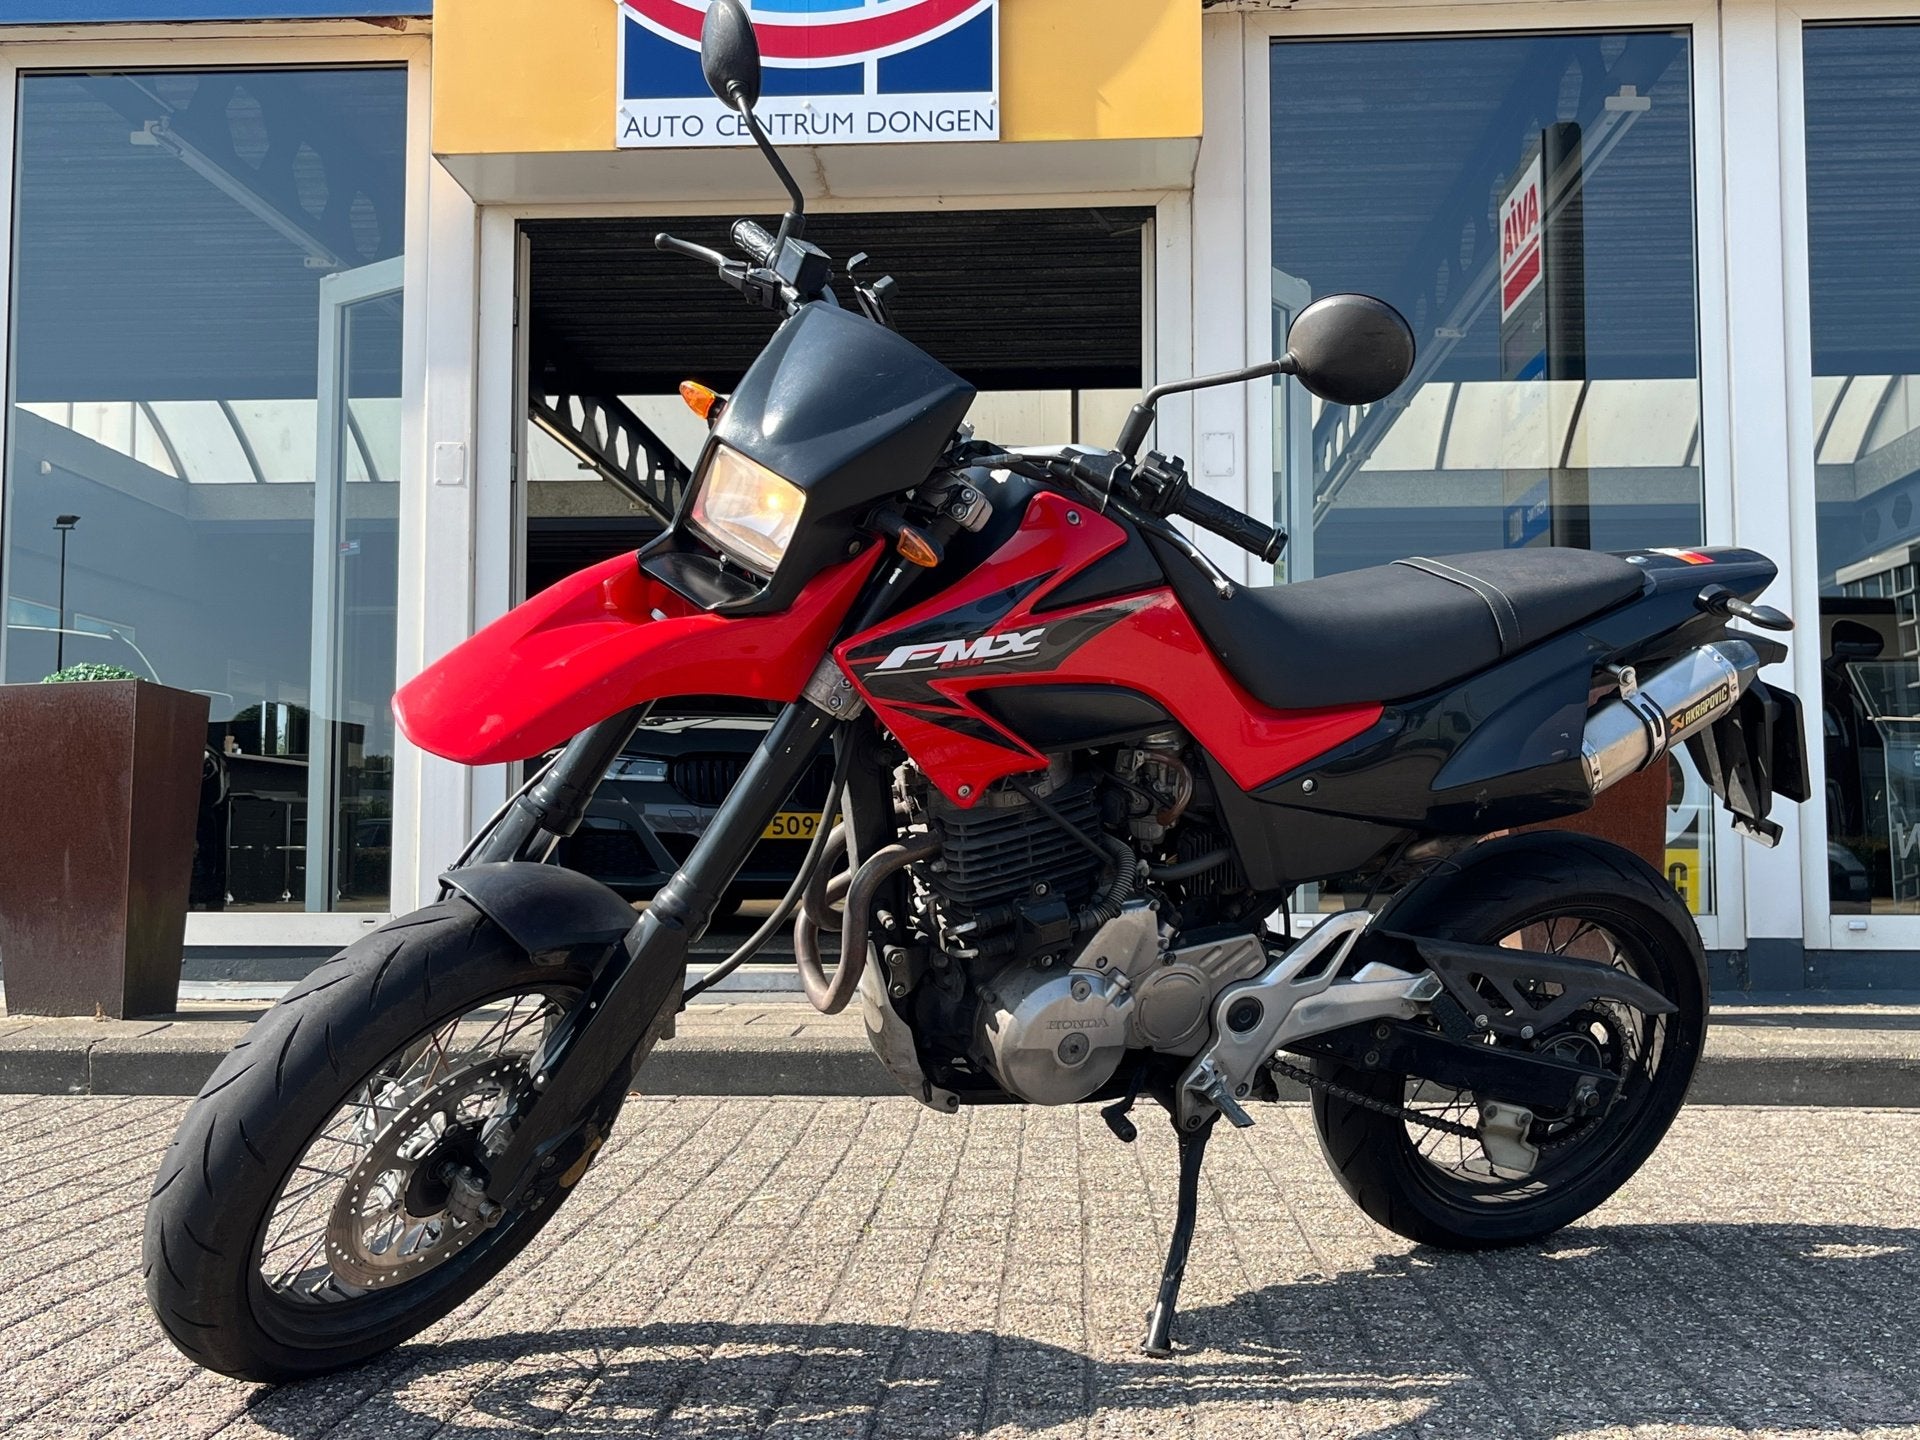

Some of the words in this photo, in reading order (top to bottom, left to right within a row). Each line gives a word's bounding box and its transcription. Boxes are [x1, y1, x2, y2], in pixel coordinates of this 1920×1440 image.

[623, 115, 704, 138] AUTO
[716, 112, 854, 137] CENTRUM
[867, 109, 994, 134] DONGEN
[875, 628, 1046, 670] FMX
[1046, 1018, 1110, 1030] HONDA
